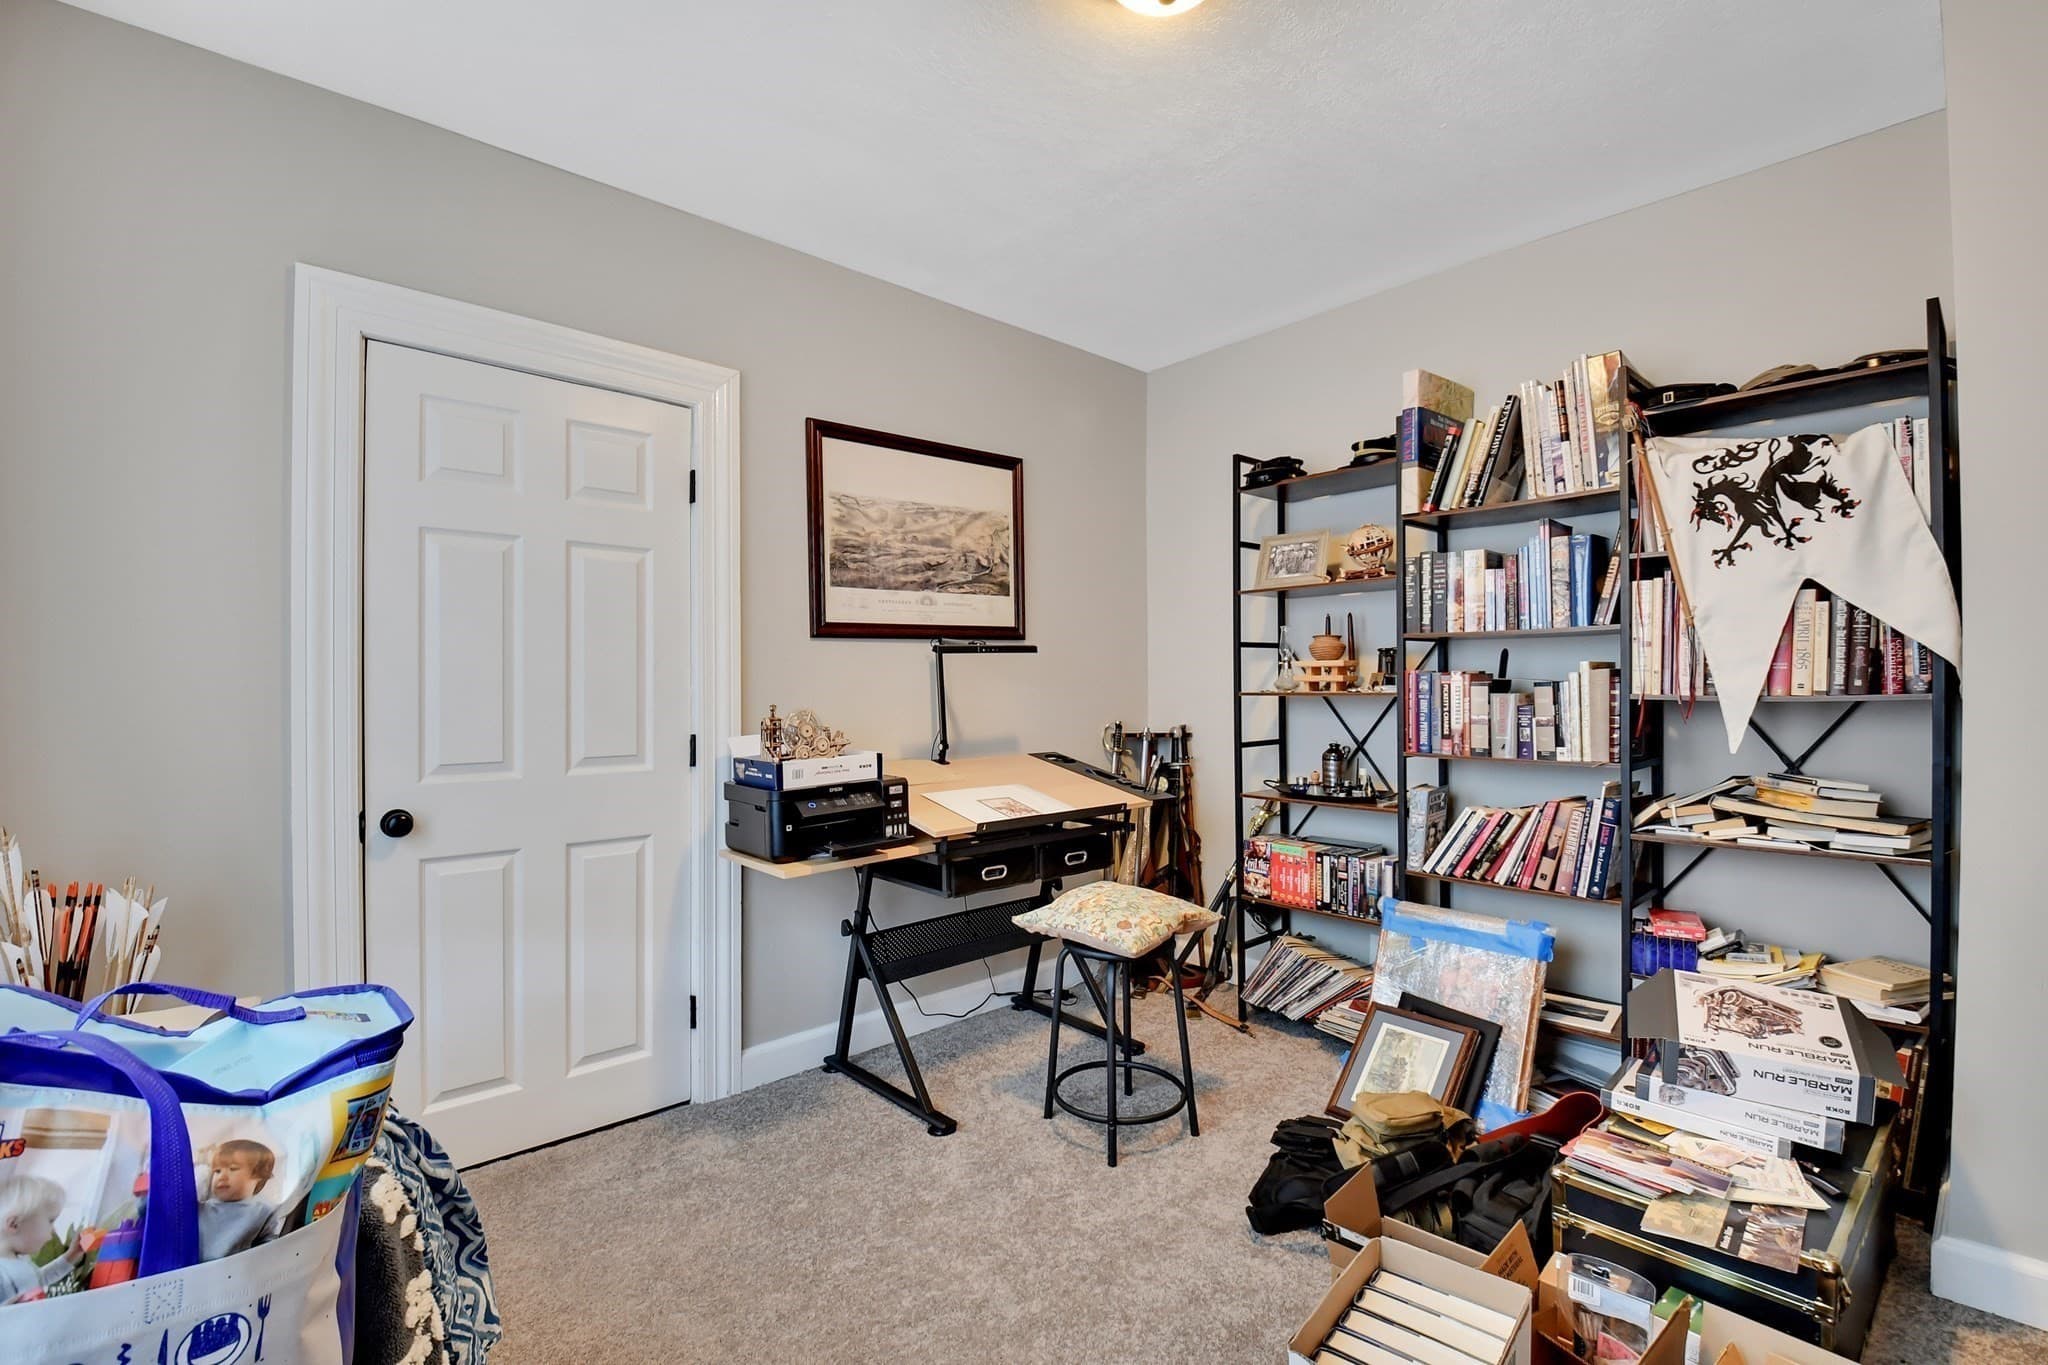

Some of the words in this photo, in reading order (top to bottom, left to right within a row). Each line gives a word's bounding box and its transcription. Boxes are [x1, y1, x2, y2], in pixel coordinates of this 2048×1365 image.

[1497, 399, 1513, 435] TWENTY
[1490, 434, 1502, 455] DAYS
[1796, 618, 1811, 644] APRIL
[1795, 648, 1811, 671] 1865
[1598, 846, 1606, 857] The
[1594, 857, 1604, 883] Leaders
[1747, 1041, 1781, 1055] RUN
[1782, 1046, 1851, 1066] MARBLE
[1752, 1069, 1786, 1083] RUN
[1788, 1074, 1853, 1095] MARBLE
[1744, 1110, 1769, 1123] RUN
[1770, 1116, 1820, 1137] MARBLE
[1719, 1129, 1738, 1140] RUN
[1737, 1133, 1774, 1149] MARBLE
